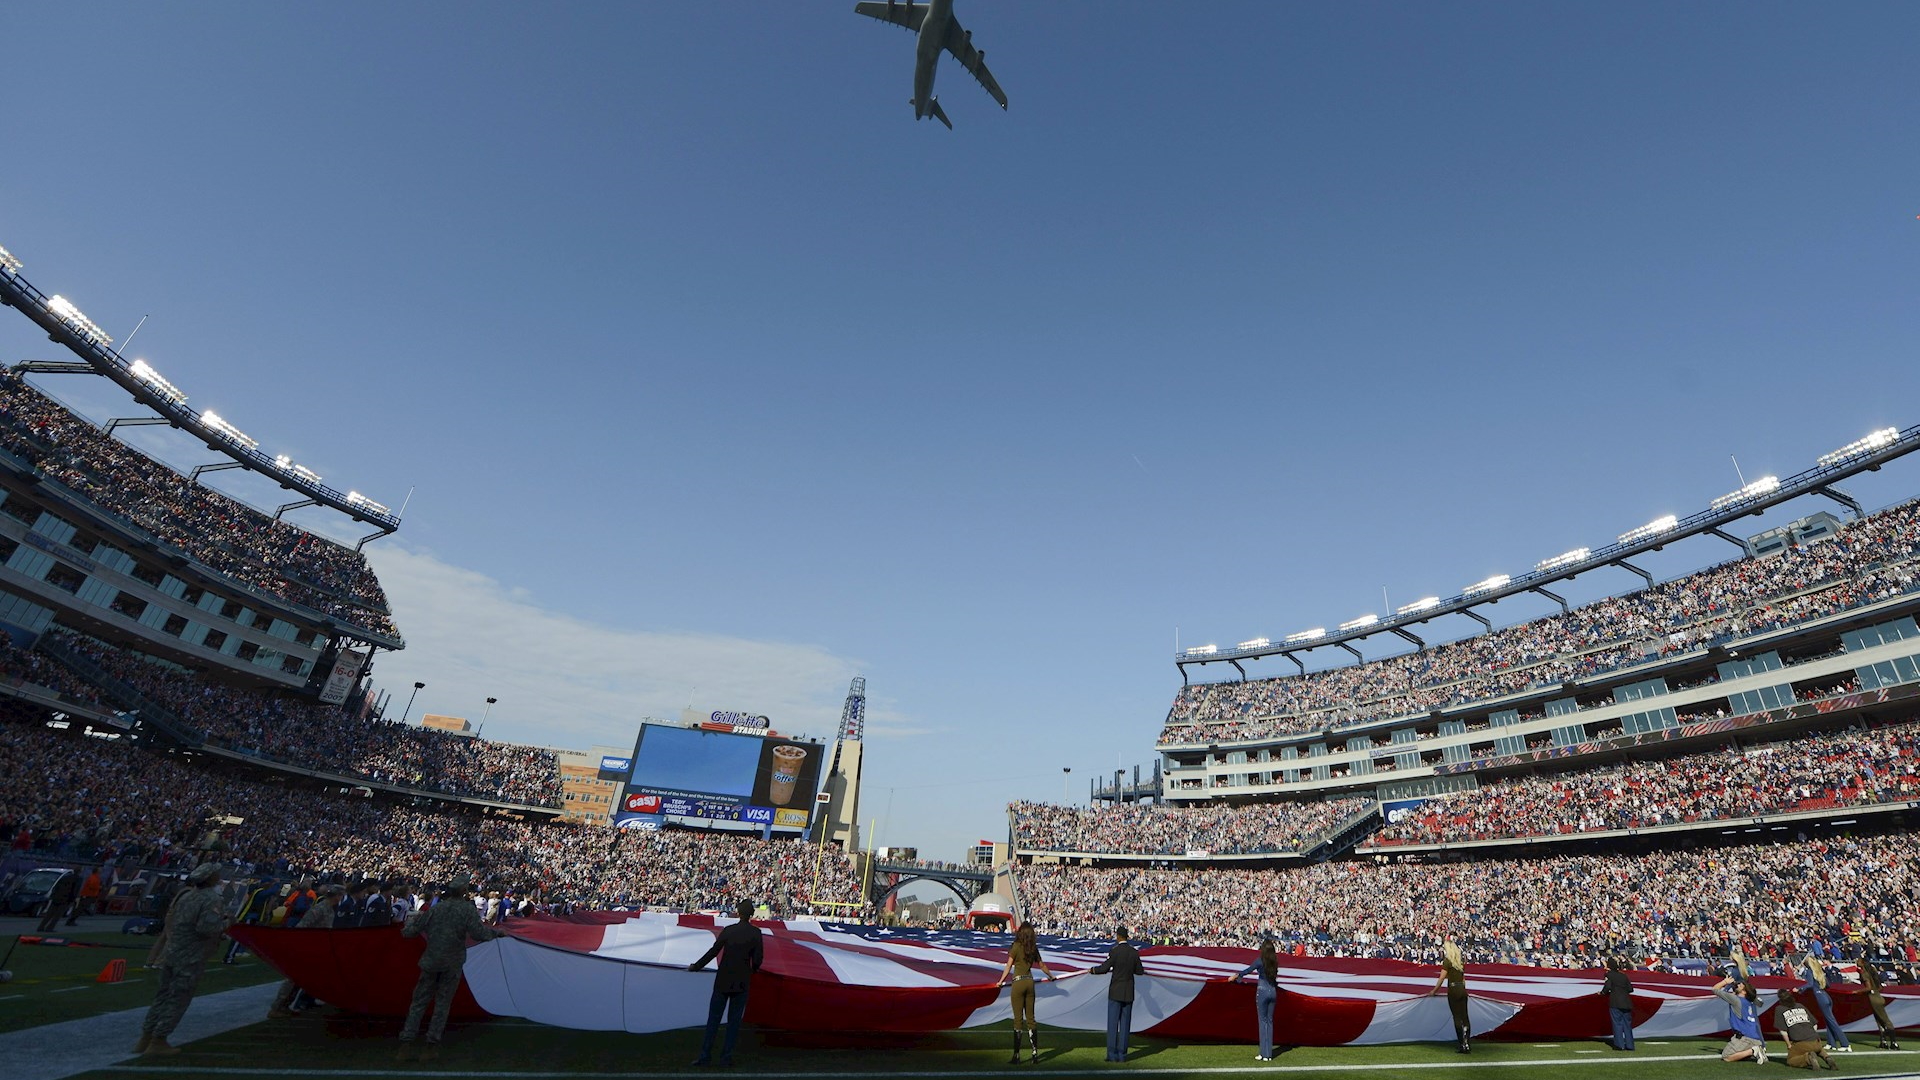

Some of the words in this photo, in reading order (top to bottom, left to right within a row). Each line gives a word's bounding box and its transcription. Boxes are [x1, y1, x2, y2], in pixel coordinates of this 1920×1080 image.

[335, 666, 355, 677] 16-0
[323, 692, 343, 700] 2007
[711, 710, 765, 728] Gillette
[732, 725, 769, 736] STADIUM
[629, 796, 656, 808] easy
[663, 802, 692, 810] BRUSCHI'S
[697, 808, 703, 816] 0
[732, 811, 738, 819] 0
[747, 809, 770, 821] VISA
[777, 810, 806, 822] CROSS
[628, 820, 657, 829] BUD
[112, 960, 125, 981] 10
[1786, 1014, 1808, 1025] CREW
